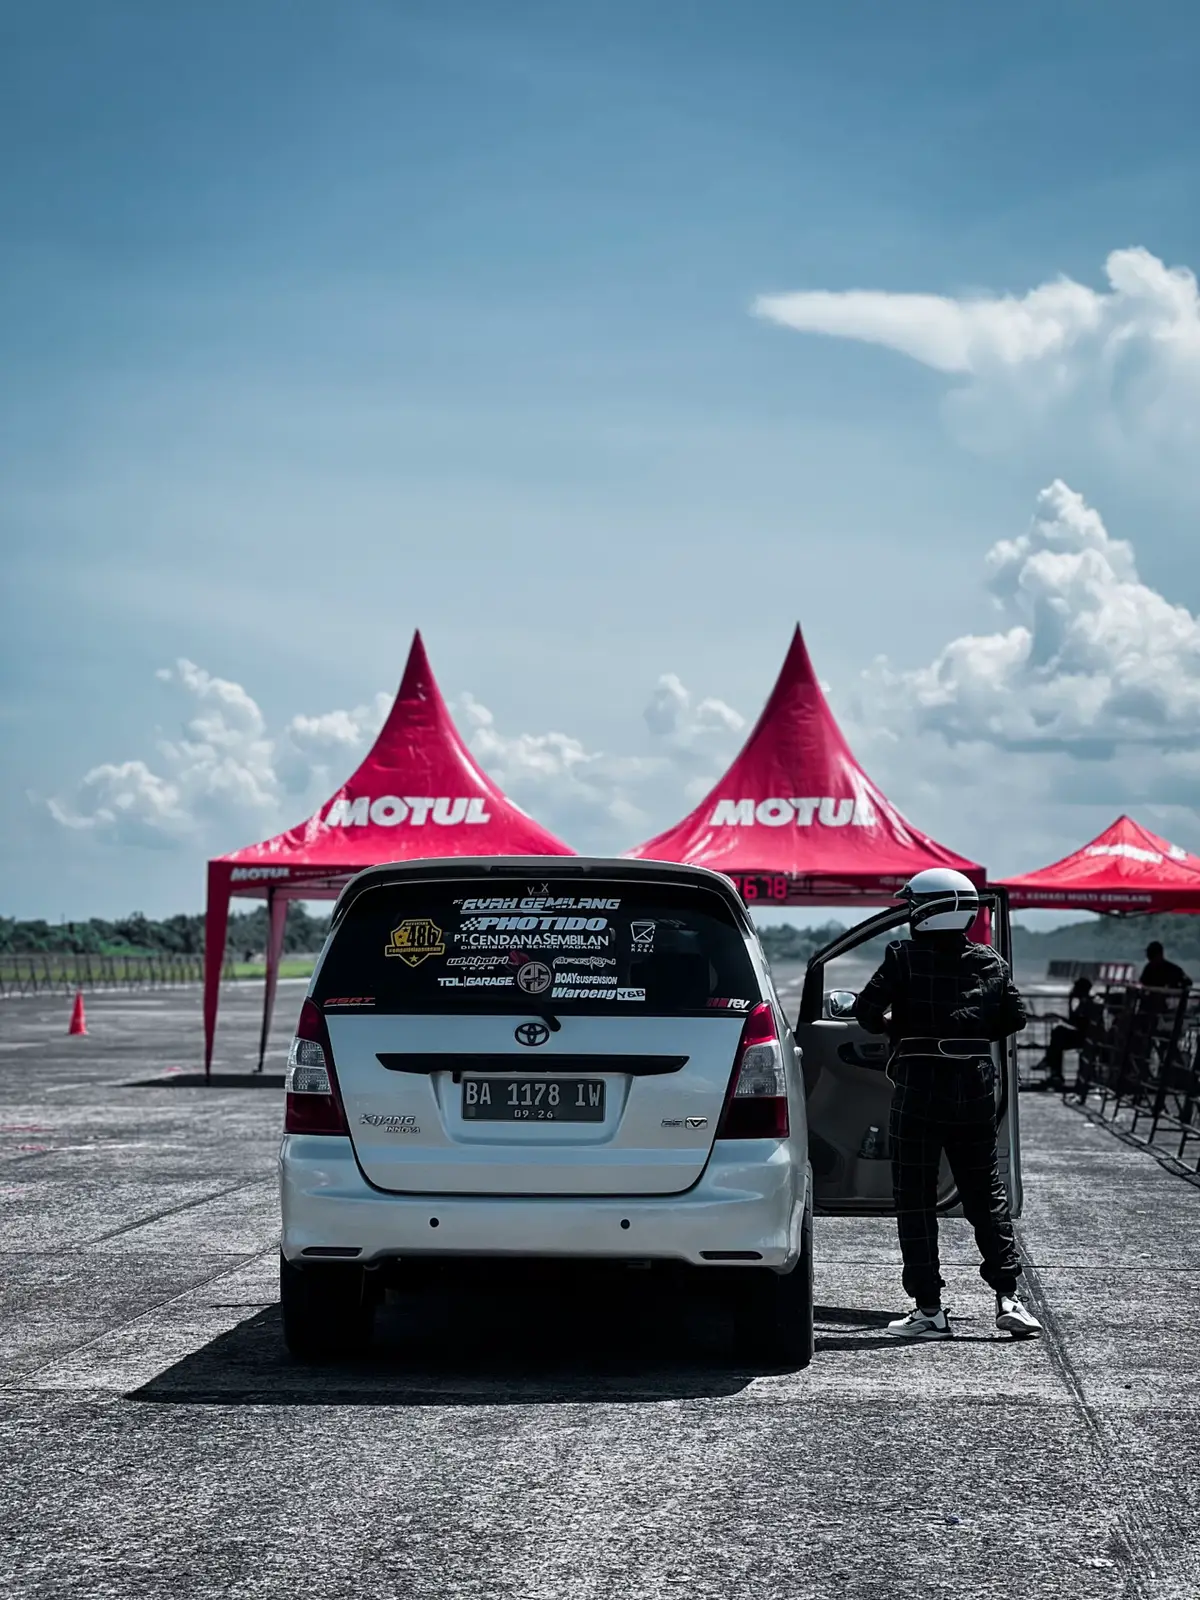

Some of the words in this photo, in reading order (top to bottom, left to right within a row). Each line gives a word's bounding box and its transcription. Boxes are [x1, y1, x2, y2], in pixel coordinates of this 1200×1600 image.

[324, 795, 491, 827] MOTUL
[708, 797, 877, 827] MOTUL
[230, 867, 290, 881] MOTUL
[462, 898, 517, 910] AYAH
[519, 897, 622, 910] GEMILANG
[476, 916, 608, 931] PHOTIDO
[551, 987, 617, 1000] Waroeng
[466, 1082, 492, 1105] BA
[507, 1083, 560, 1106] 1178
[575, 1084, 601, 1107] IW
[360, 1113, 415, 1127] KIJANG
[384, 1126, 421, 1134] INNOVA
